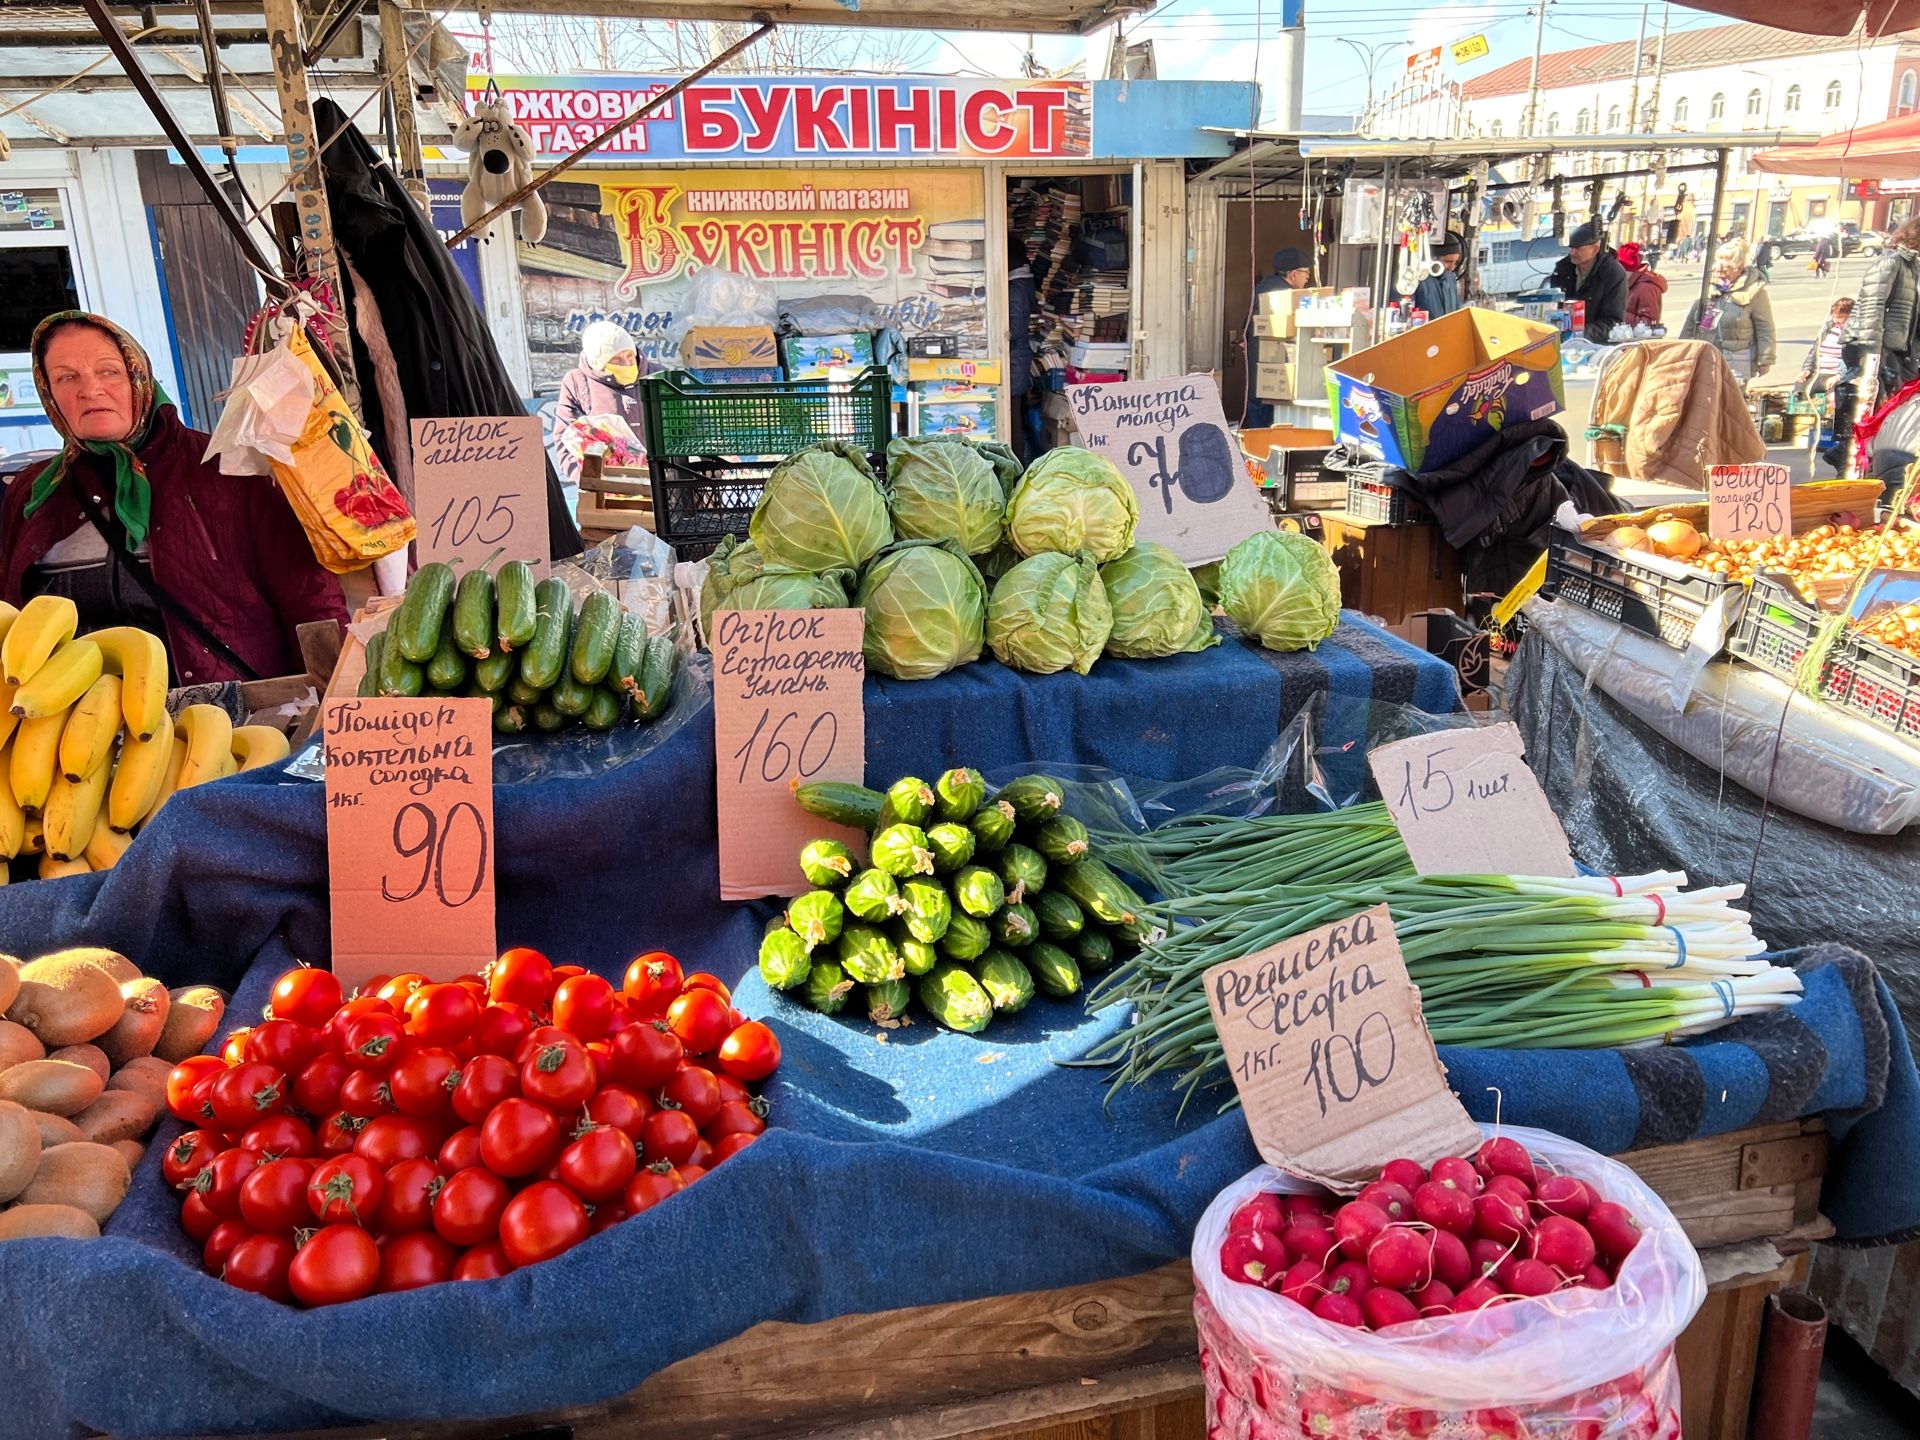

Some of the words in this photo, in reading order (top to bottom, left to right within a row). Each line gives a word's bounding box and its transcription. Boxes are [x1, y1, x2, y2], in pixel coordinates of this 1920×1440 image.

[464, 86, 674, 120] НИЖКОВИЙ
[683, 87, 1067, 153] БУКІНІСТ
[516, 123, 646, 151] ГАЗИН
[687, 185, 816, 212] книжковий
[819, 188, 910, 210] магазин
[1072, 384, 1204, 416] Капуста
[1116, 403, 1193, 432] молода
[420, 419, 510, 456] Огірок
[1127, 422, 1235, 515] 70
[431, 494, 521, 549] 105
[1727, 502, 1783, 535] 120
[719, 611, 825, 656] Огірок
[327, 700, 456, 745] Помідор
[734, 708, 837, 783] 160
[369, 766, 474, 796] солодка
[1400, 747, 1455, 821] 15
[381, 801, 488, 908] 90
[1214, 914, 1379, 1030] Редиска
[1302, 1011, 1397, 1119] 100
